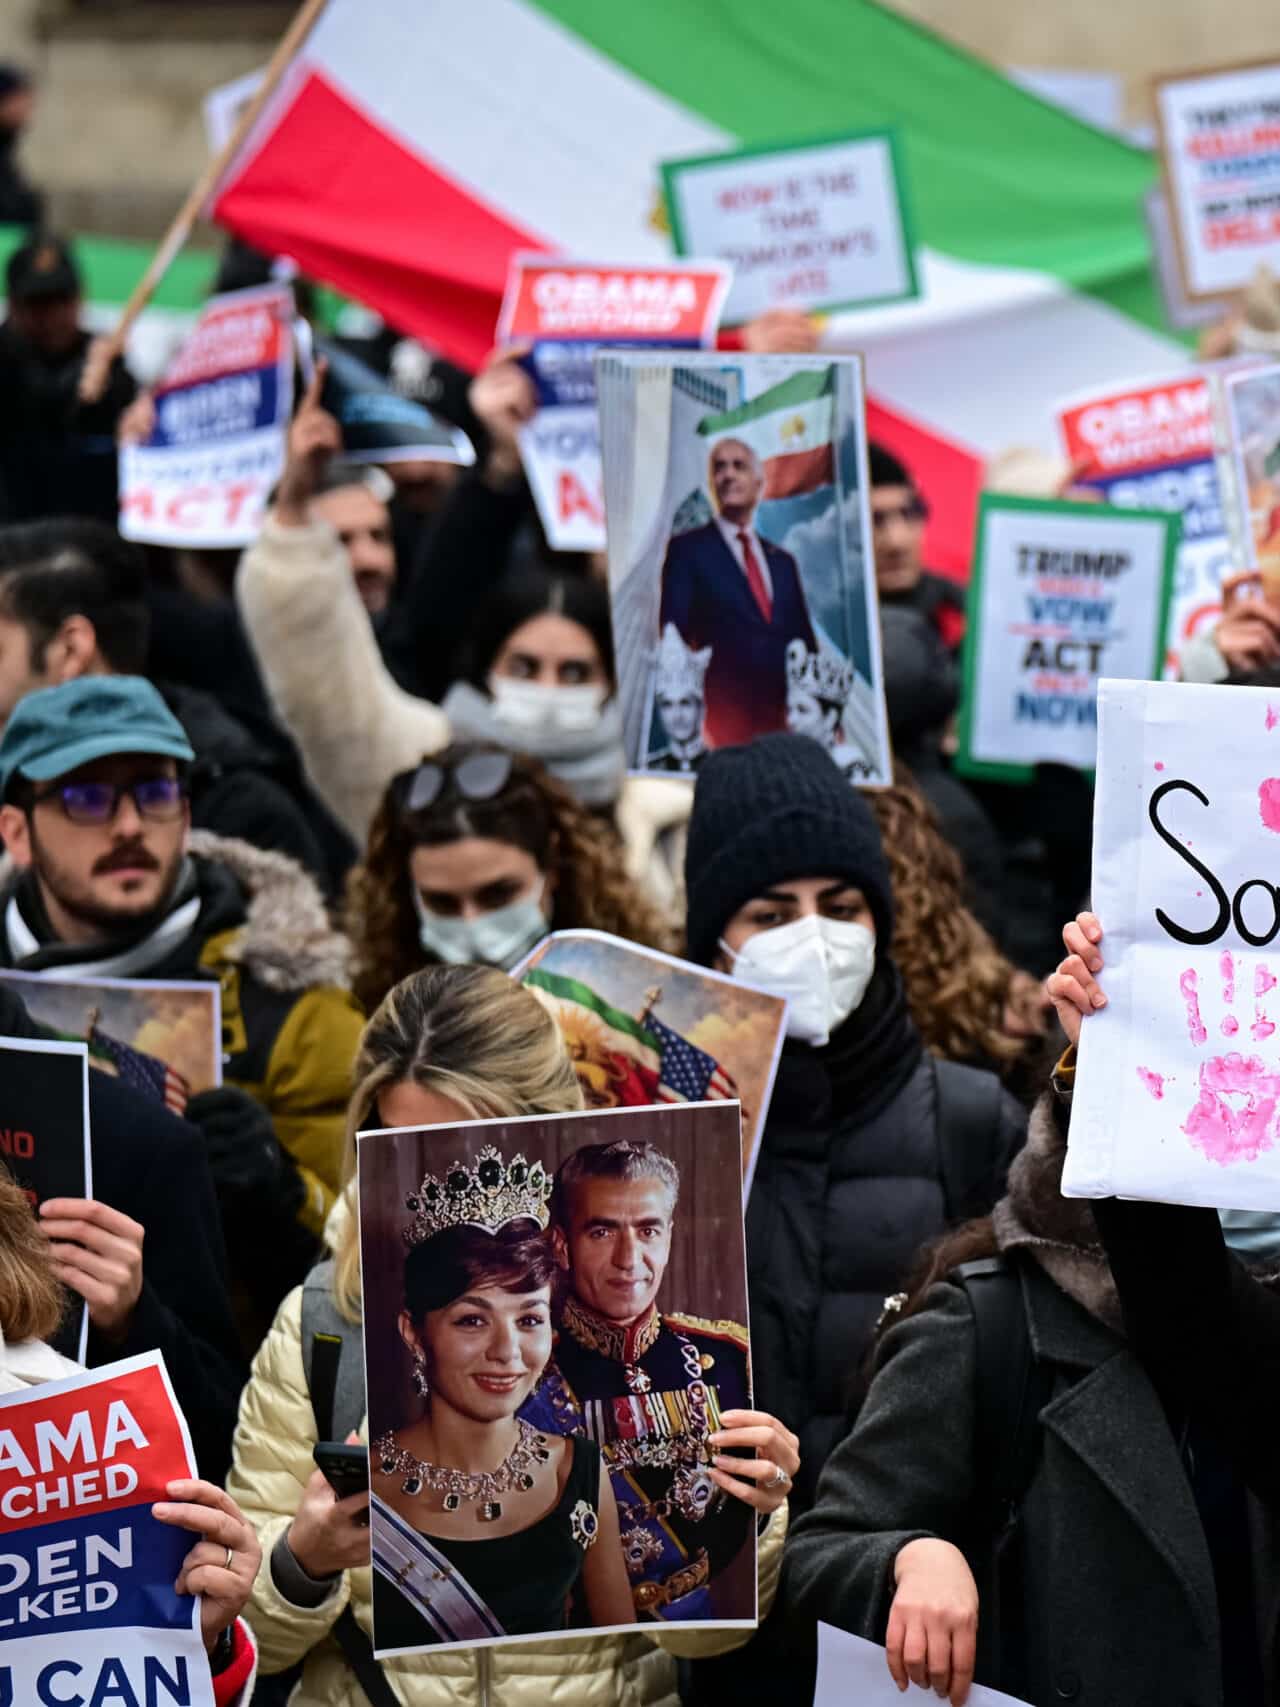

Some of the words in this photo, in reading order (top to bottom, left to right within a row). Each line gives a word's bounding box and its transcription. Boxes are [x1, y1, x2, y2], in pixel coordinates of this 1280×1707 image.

[534, 273, 697, 311] OBAMA
[1017, 546, 1131, 577] TRUMP
[1027, 597, 1113, 623] VOW
[1023, 640, 1105, 673] ACT
[0, 1399, 150, 1478] AMA
[1, 1463, 138, 1519] CHED
[0, 1527, 133, 1595] DEN
[36, 1656, 191, 1707] CAN
